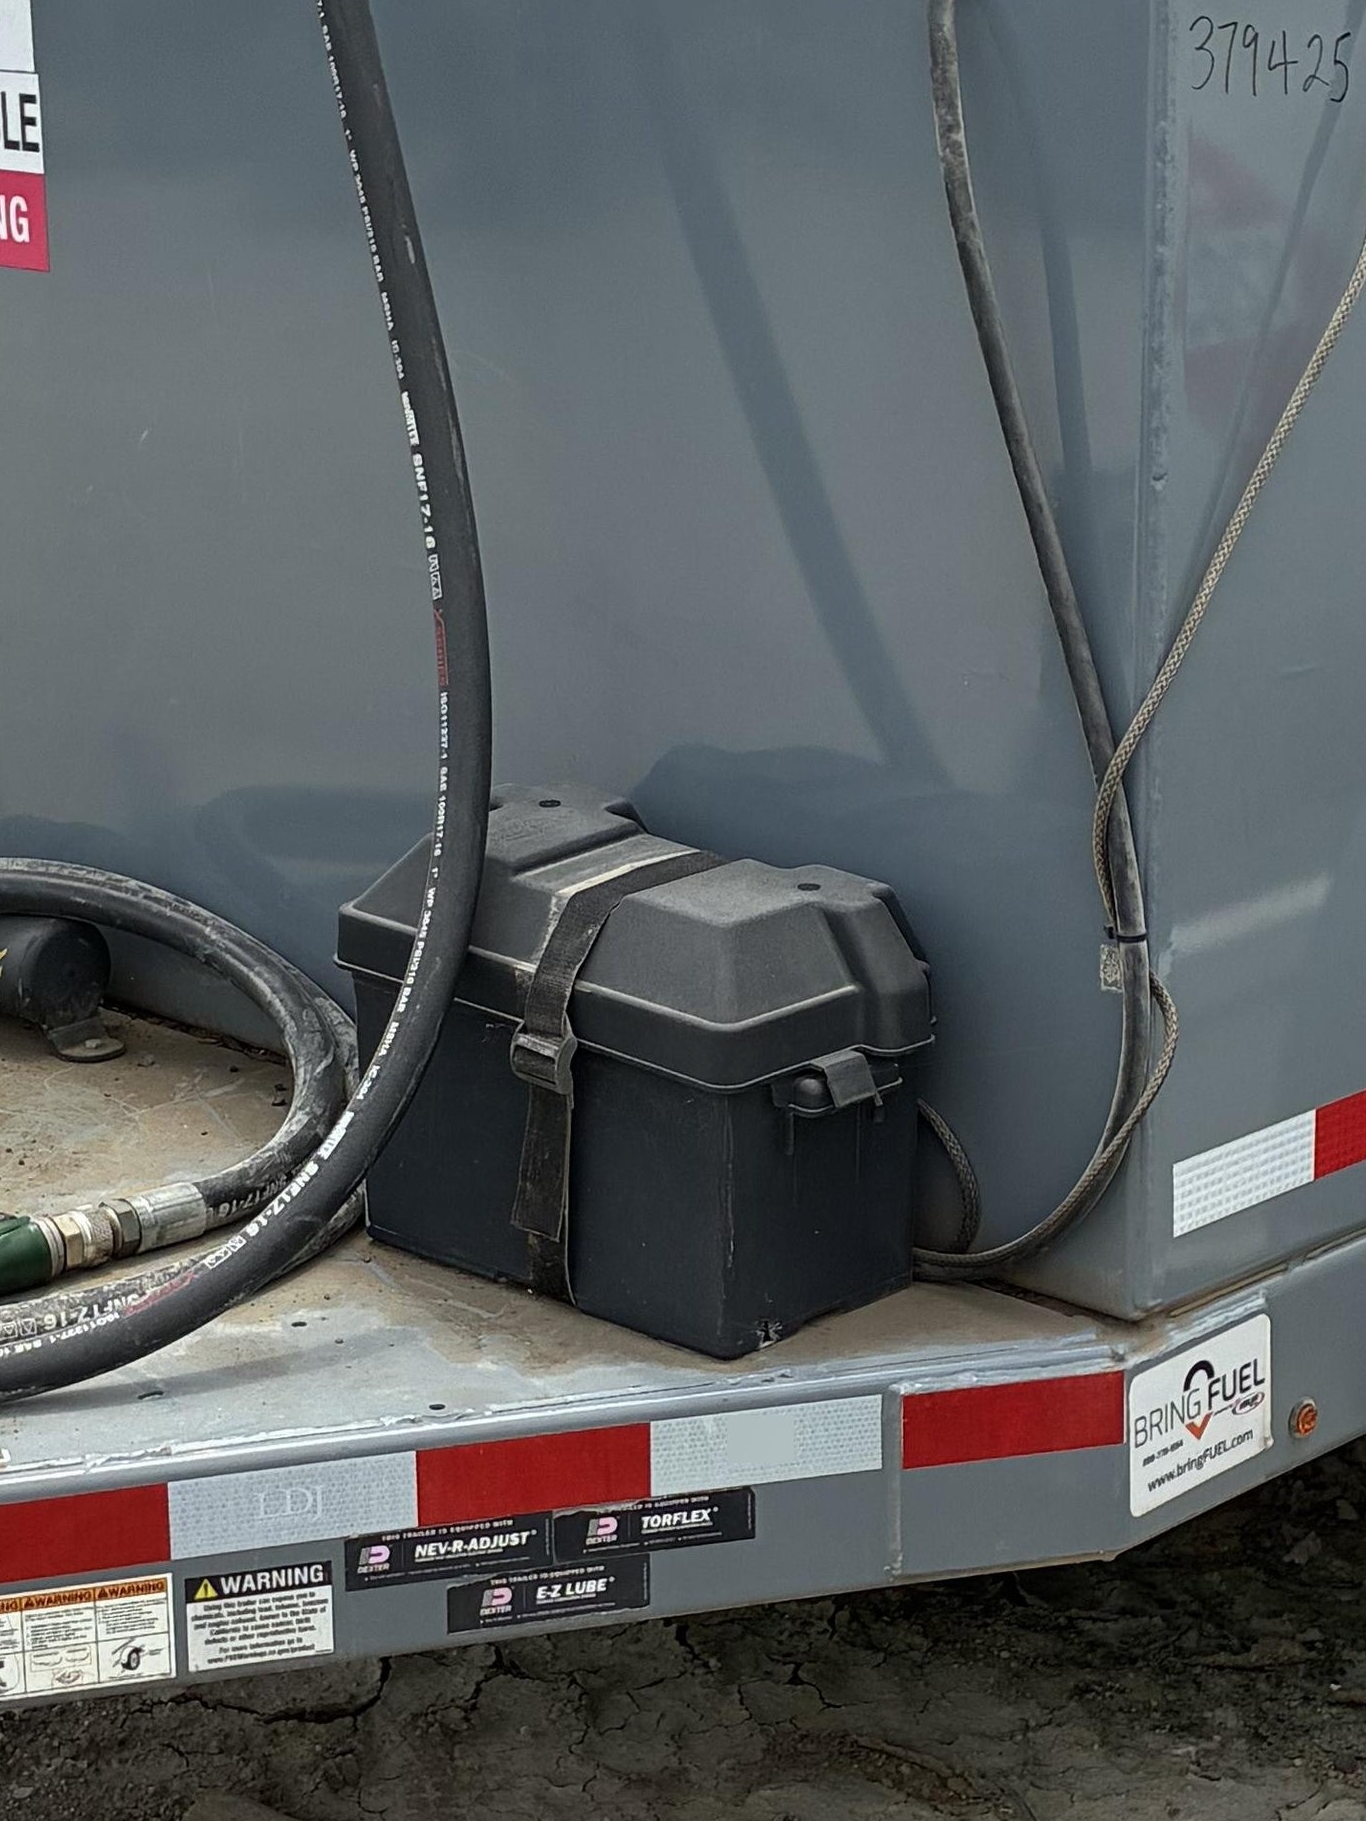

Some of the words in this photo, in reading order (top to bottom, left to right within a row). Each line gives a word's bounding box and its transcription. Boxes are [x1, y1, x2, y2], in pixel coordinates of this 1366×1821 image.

[1189, 14, 1353, 103] 379425
[1135, 1388, 1201, 1448] BRING
[1208, 1358, 1265, 1410] FUEL
[641, 1508, 712, 1529] TORFLEX
[414, 1532, 530, 1558] NEV-R-ADJUST
[586, 1535, 617, 1545] DEXTER
[357, 1563, 390, 1574] DEXTER
[108, 1582, 165, 1598] WARNING
[221, 1564, 324, 1595] WARNING
[536, 1585, 561, 1599] E-Z
[566, 1578, 607, 1596] LUBE
[35, 1591, 92, 1607] WARNING
[480, 1605, 512, 1616] DEXTER
